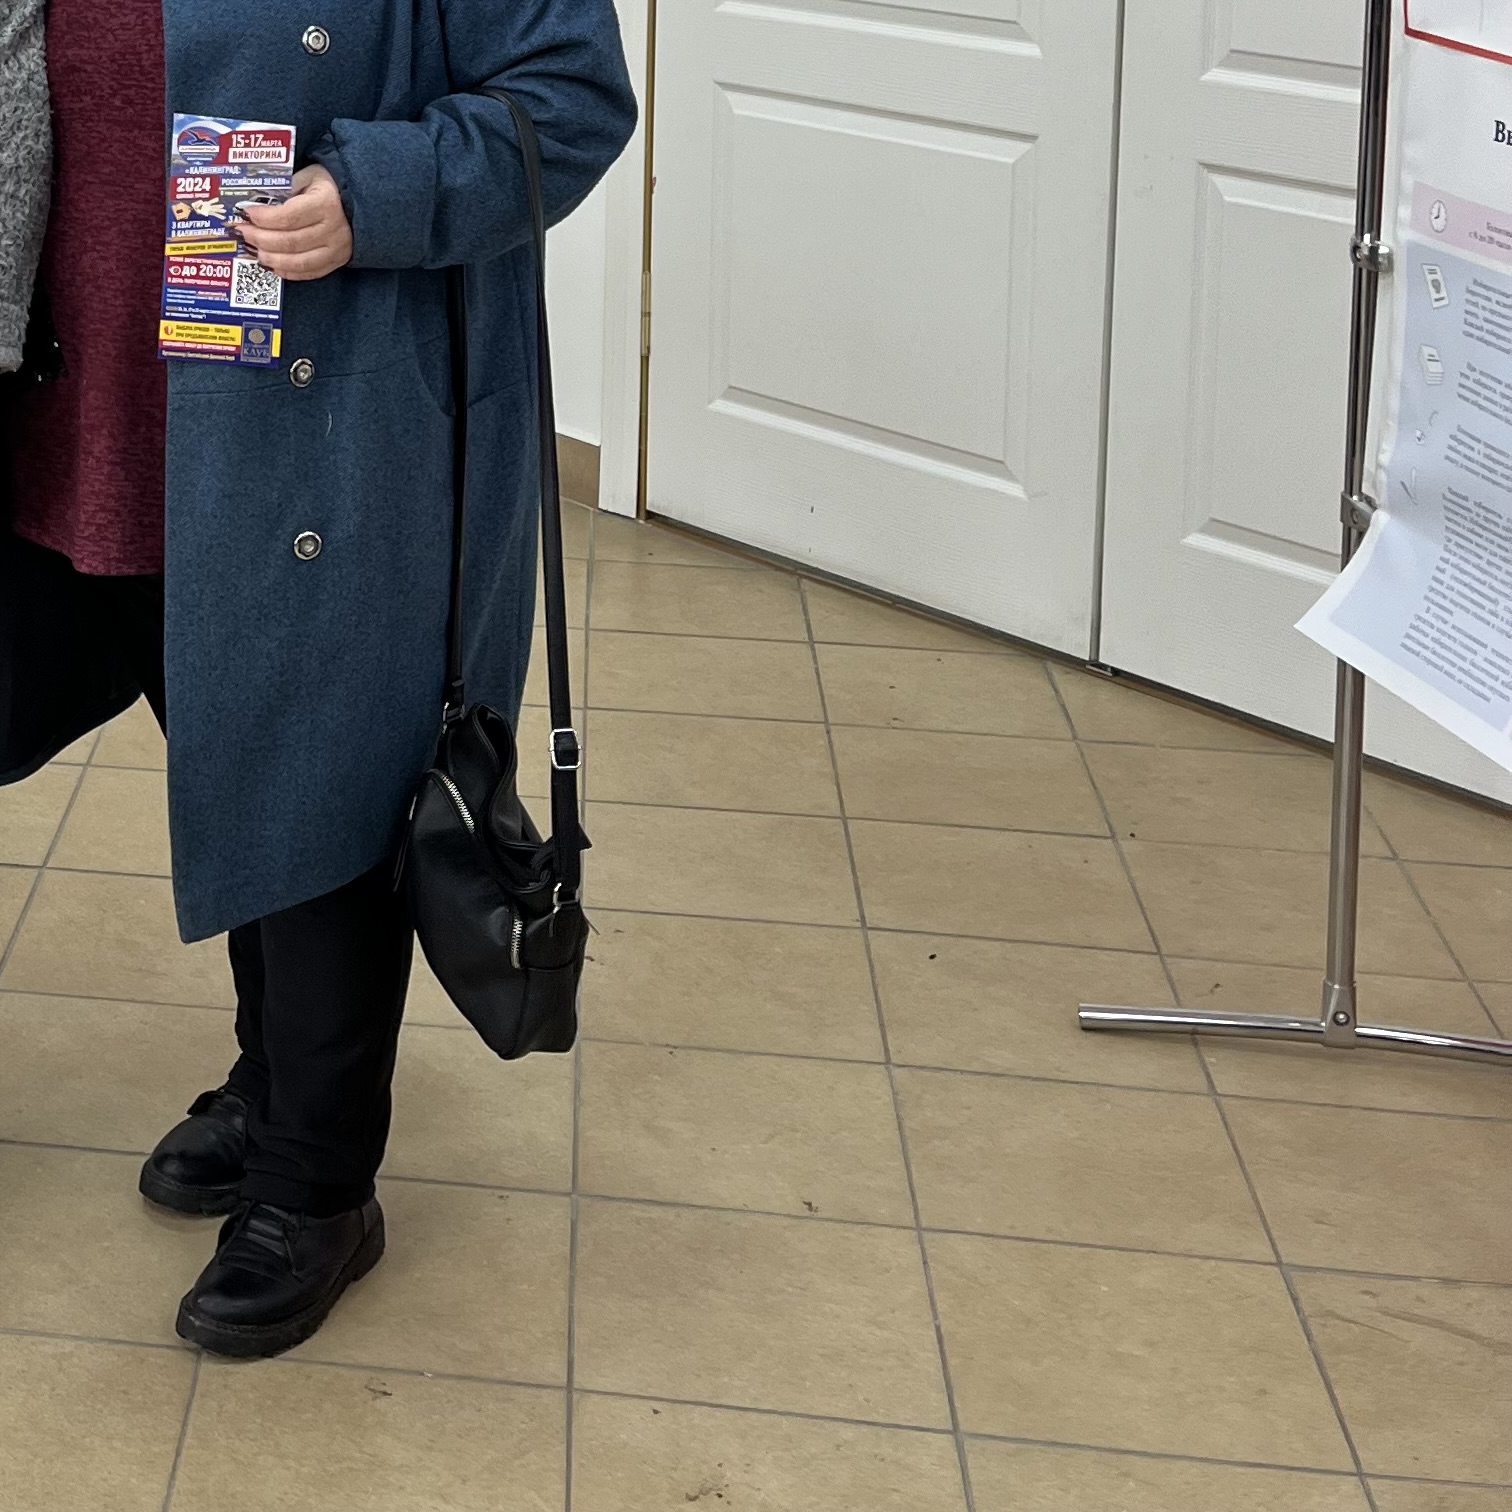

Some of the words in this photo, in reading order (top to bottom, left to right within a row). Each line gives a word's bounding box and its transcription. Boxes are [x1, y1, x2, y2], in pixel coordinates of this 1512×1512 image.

[231, 133, 264, 148] 15-17
[232, 150, 282, 160] ВИКТОРИНА
[176, 177, 212, 193] 2024
[177, 220, 211, 229] КВАРТИРЫ
[181, 266, 197, 277] ДО
[199, 264, 231, 278] 20:00
